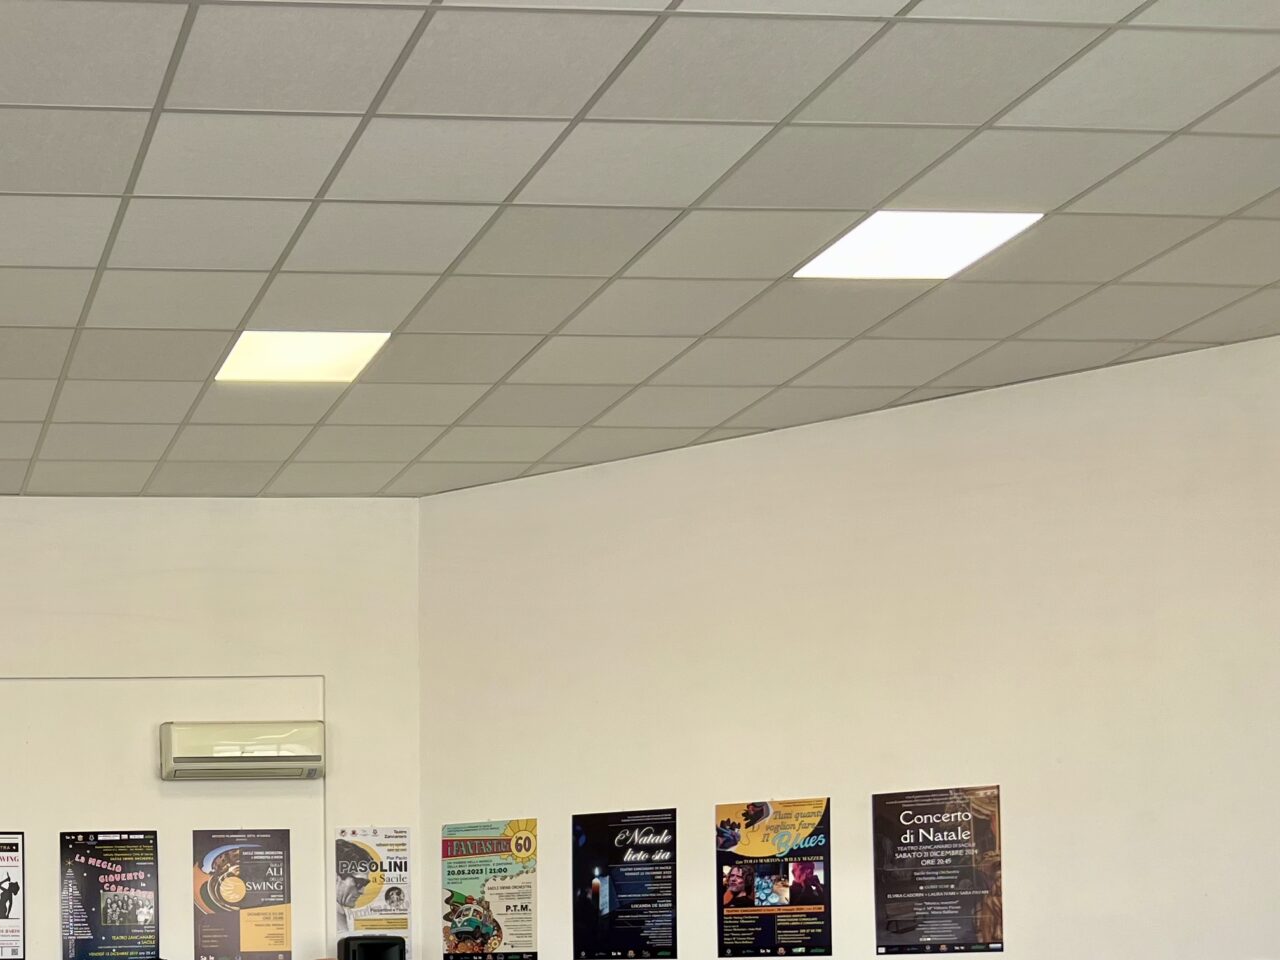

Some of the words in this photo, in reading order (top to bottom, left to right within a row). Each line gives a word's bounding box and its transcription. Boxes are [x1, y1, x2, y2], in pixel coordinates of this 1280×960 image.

[794, 811, 822, 821] quanti
[900, 811, 972, 825] Concerto
[766, 821, 796, 833] voglion
[615, 827, 672, 847] Natale
[901, 830, 914, 843] di
[919, 826, 971, 842] Natale
[771, 831, 826, 857] Blues
[624, 848, 649, 862] lieto
[652, 850, 671, 860] sia
[88, 858, 122, 872] MEGLIO
[266, 867, 283, 876] ALI
[339, 860, 408, 873] PASOLINI
[380, 874, 407, 882] Sacile
[246, 881, 283, 890] SWING
